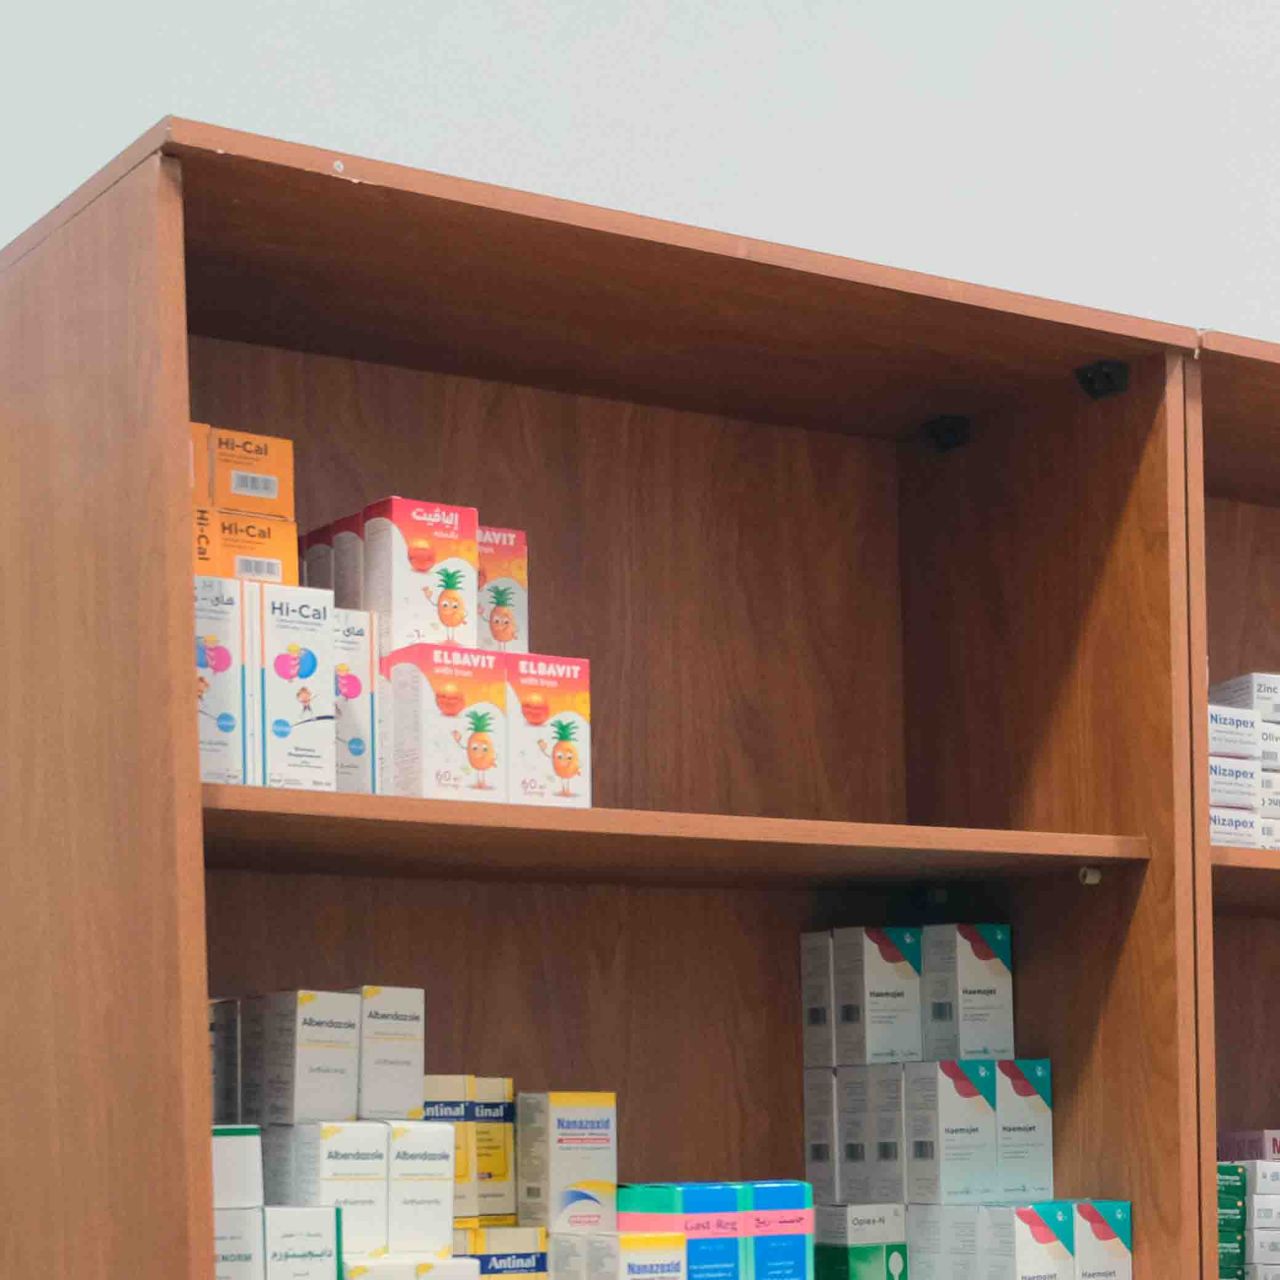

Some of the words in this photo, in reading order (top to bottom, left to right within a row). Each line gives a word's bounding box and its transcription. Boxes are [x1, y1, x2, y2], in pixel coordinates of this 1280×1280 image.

[218, 437, 268, 456] Hi-Cal
[196, 508, 210, 561] Hi-Cal
[221, 521, 271, 539] Hi-Cal
[271, 601, 327, 621] Hi-Cal
[433, 650, 496, 669] ELBAVIT
[519, 660, 580, 679] ELBAVIT
[1256, 683, 1278, 695] Zinc
[1210, 713, 1255, 729] Nizapex
[1210, 765, 1254, 779] Nizapex
[488, 1256, 537, 1271] Antinal
